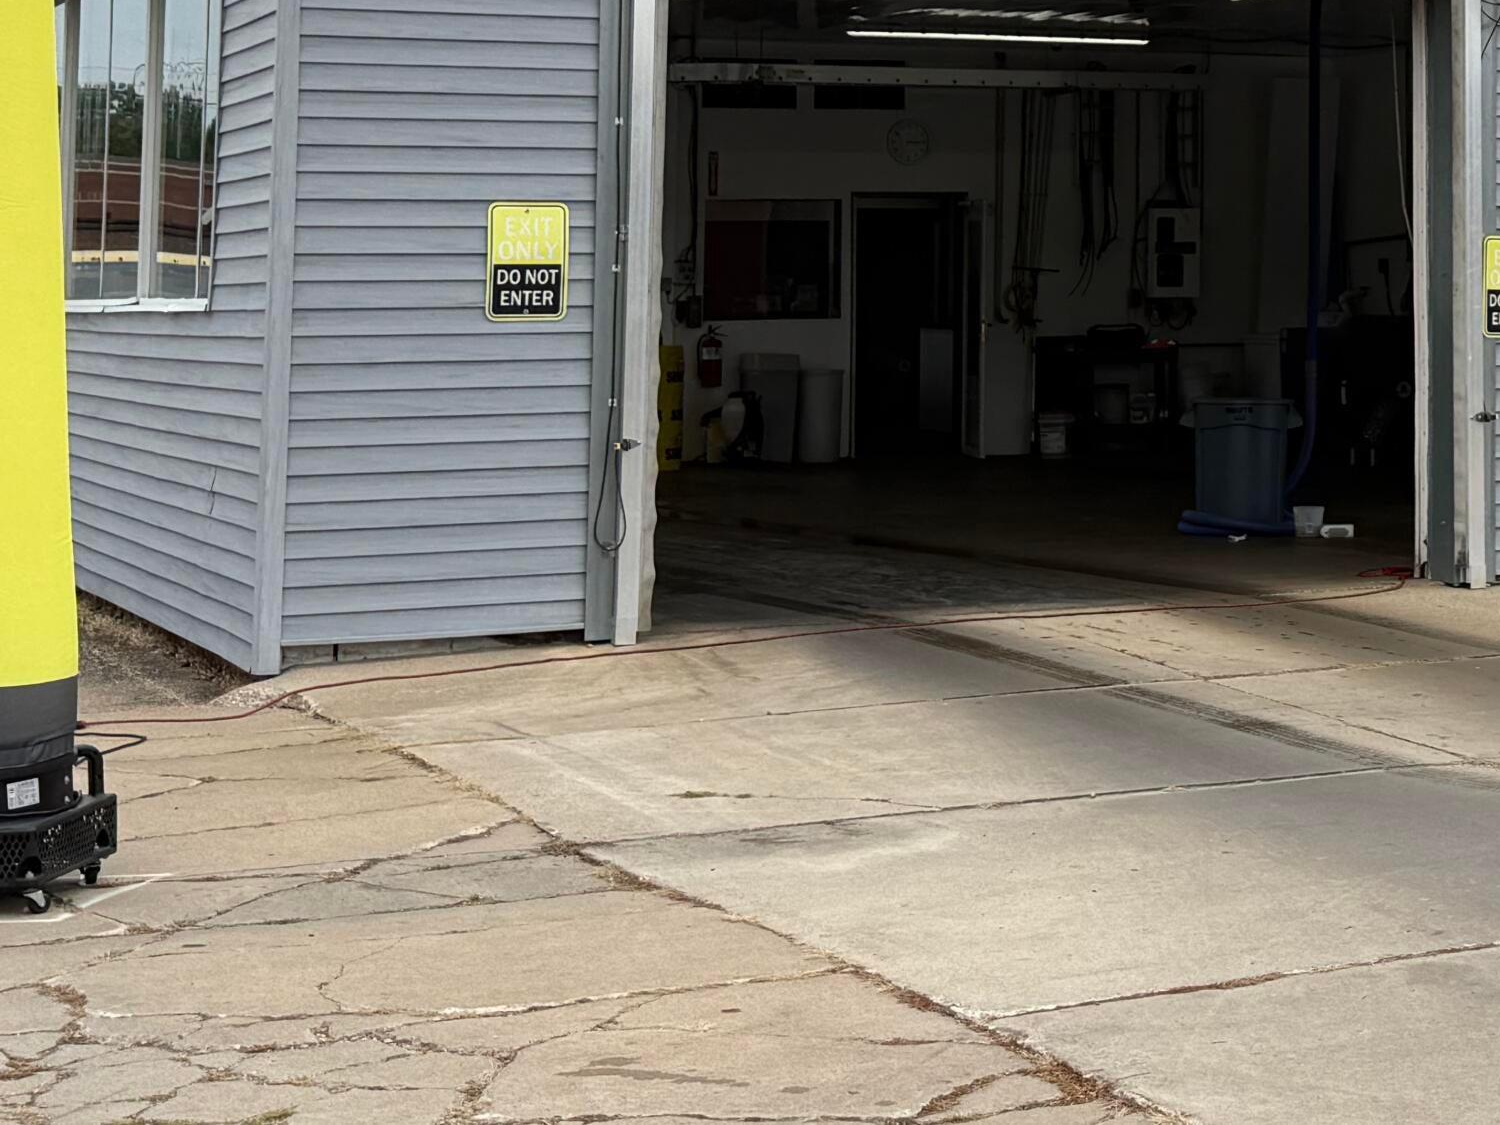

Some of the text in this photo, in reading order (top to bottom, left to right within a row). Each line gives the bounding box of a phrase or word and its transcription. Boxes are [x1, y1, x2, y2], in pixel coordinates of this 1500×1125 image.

[504, 216, 553, 237] EXIT
[498, 241, 559, 261] ONLY
[496, 268, 559, 285] DO NOT
[500, 290, 554, 306] ENTER
